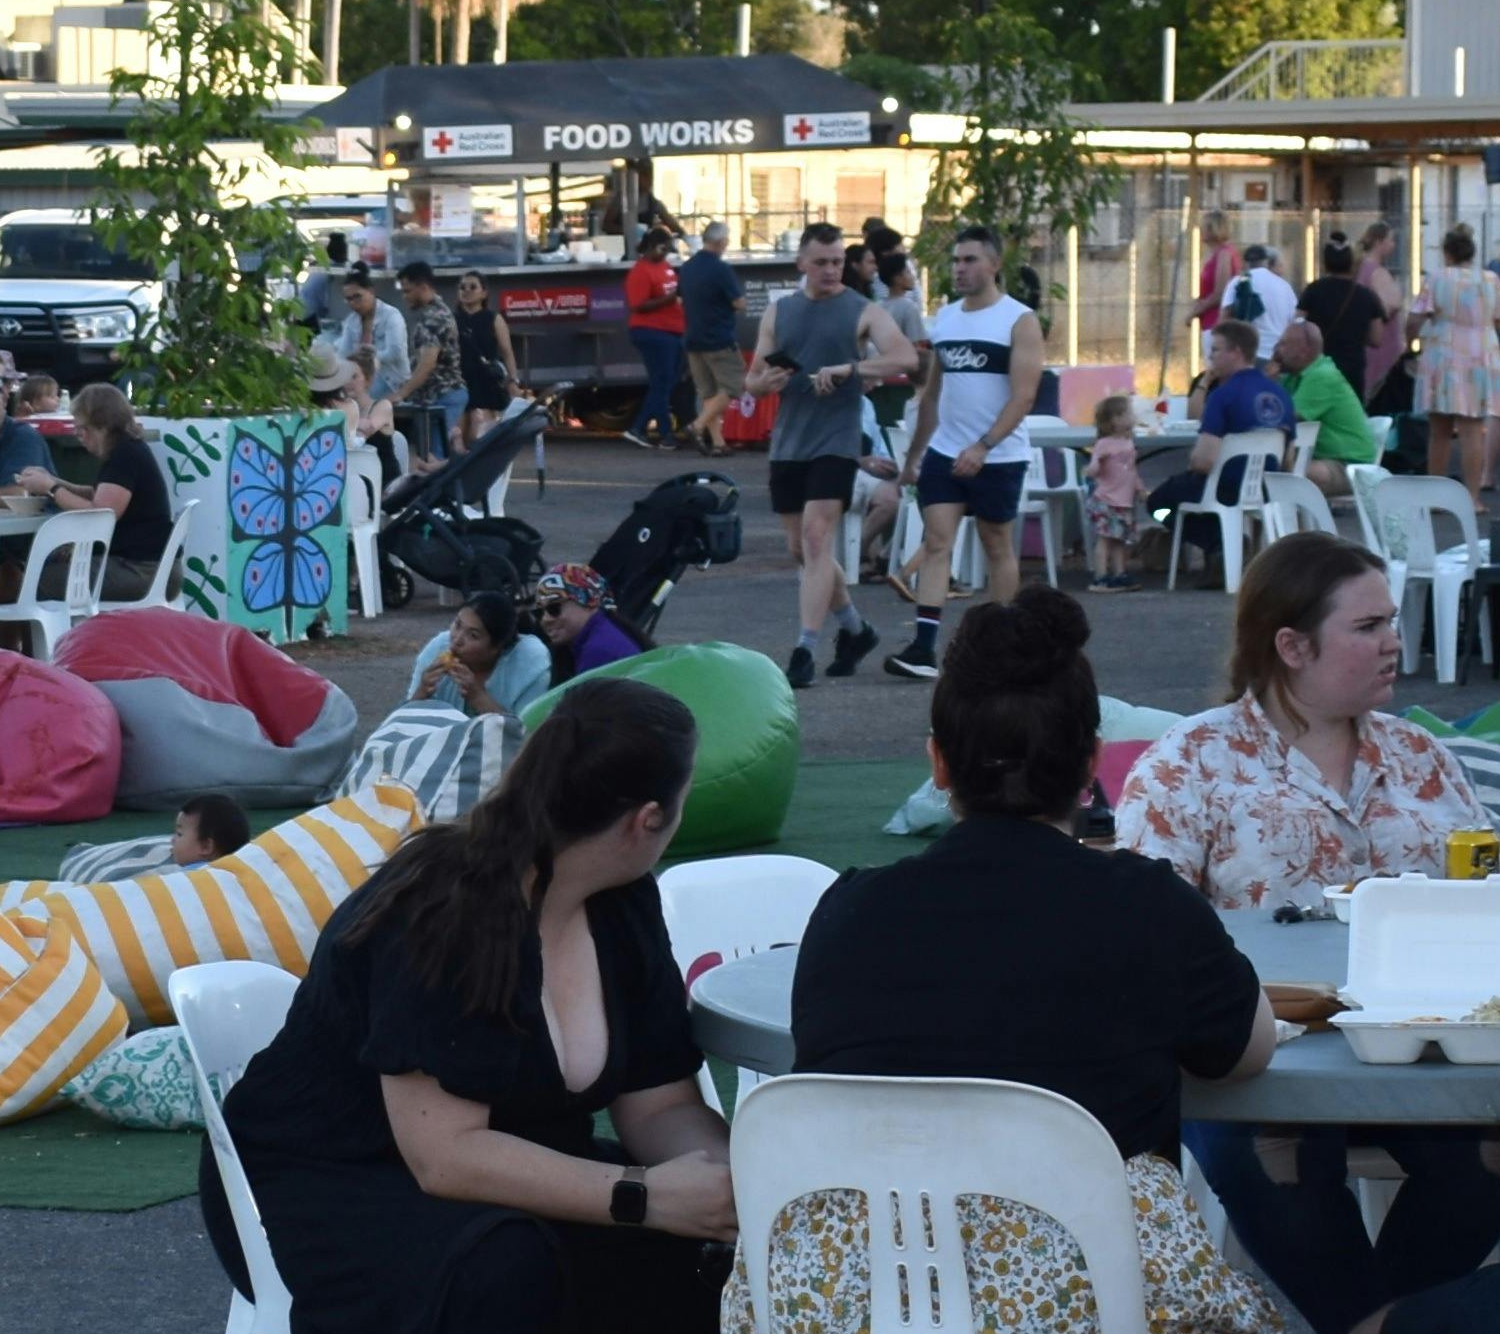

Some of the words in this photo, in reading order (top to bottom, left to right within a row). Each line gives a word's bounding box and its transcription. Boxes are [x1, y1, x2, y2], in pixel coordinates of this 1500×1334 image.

[458, 131, 505, 140] Australian
[544, 123, 631, 151] FOOD
[640, 119, 755, 146] WORKS
[819, 128, 836, 137] Red
[838, 128, 863, 137] Cross
[459, 141, 477, 151] Red
[479, 141, 505, 151] Cross
